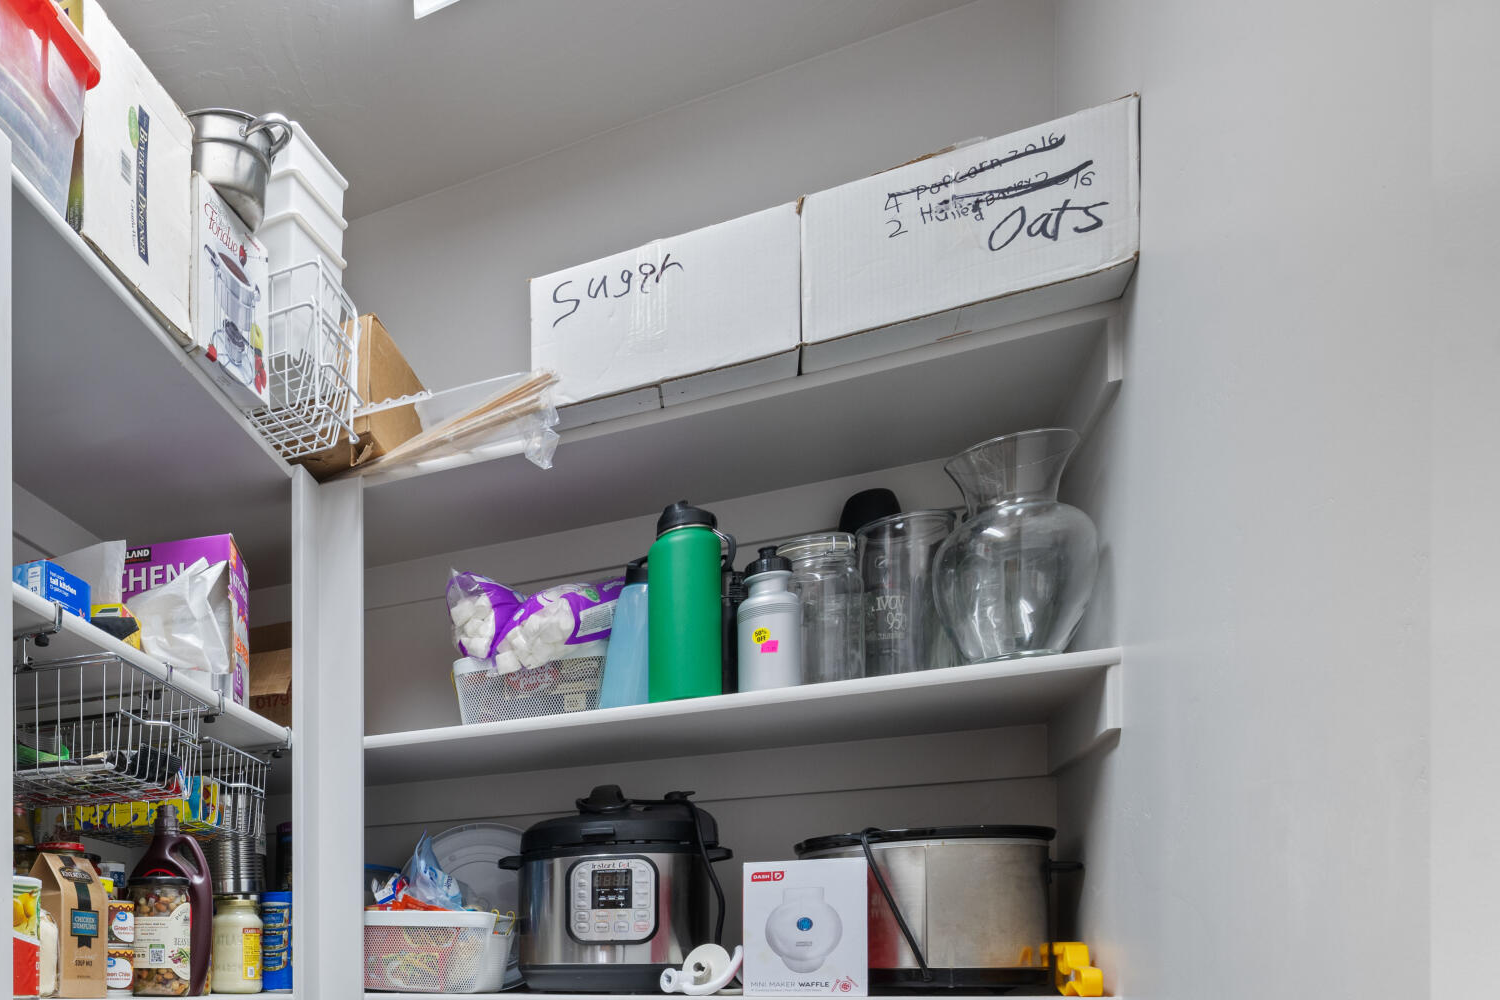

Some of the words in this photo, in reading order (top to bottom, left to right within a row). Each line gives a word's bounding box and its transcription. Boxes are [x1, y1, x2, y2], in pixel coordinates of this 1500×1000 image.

[138, 125, 148, 188] BEVERAGE
[204, 203, 238, 257] Fondue
[885, 219, 908, 238] 2
[988, 199, 1109, 252] Oats
[58, 580, 77, 596] kitchen
[122, 562, 186, 593] CHEN
